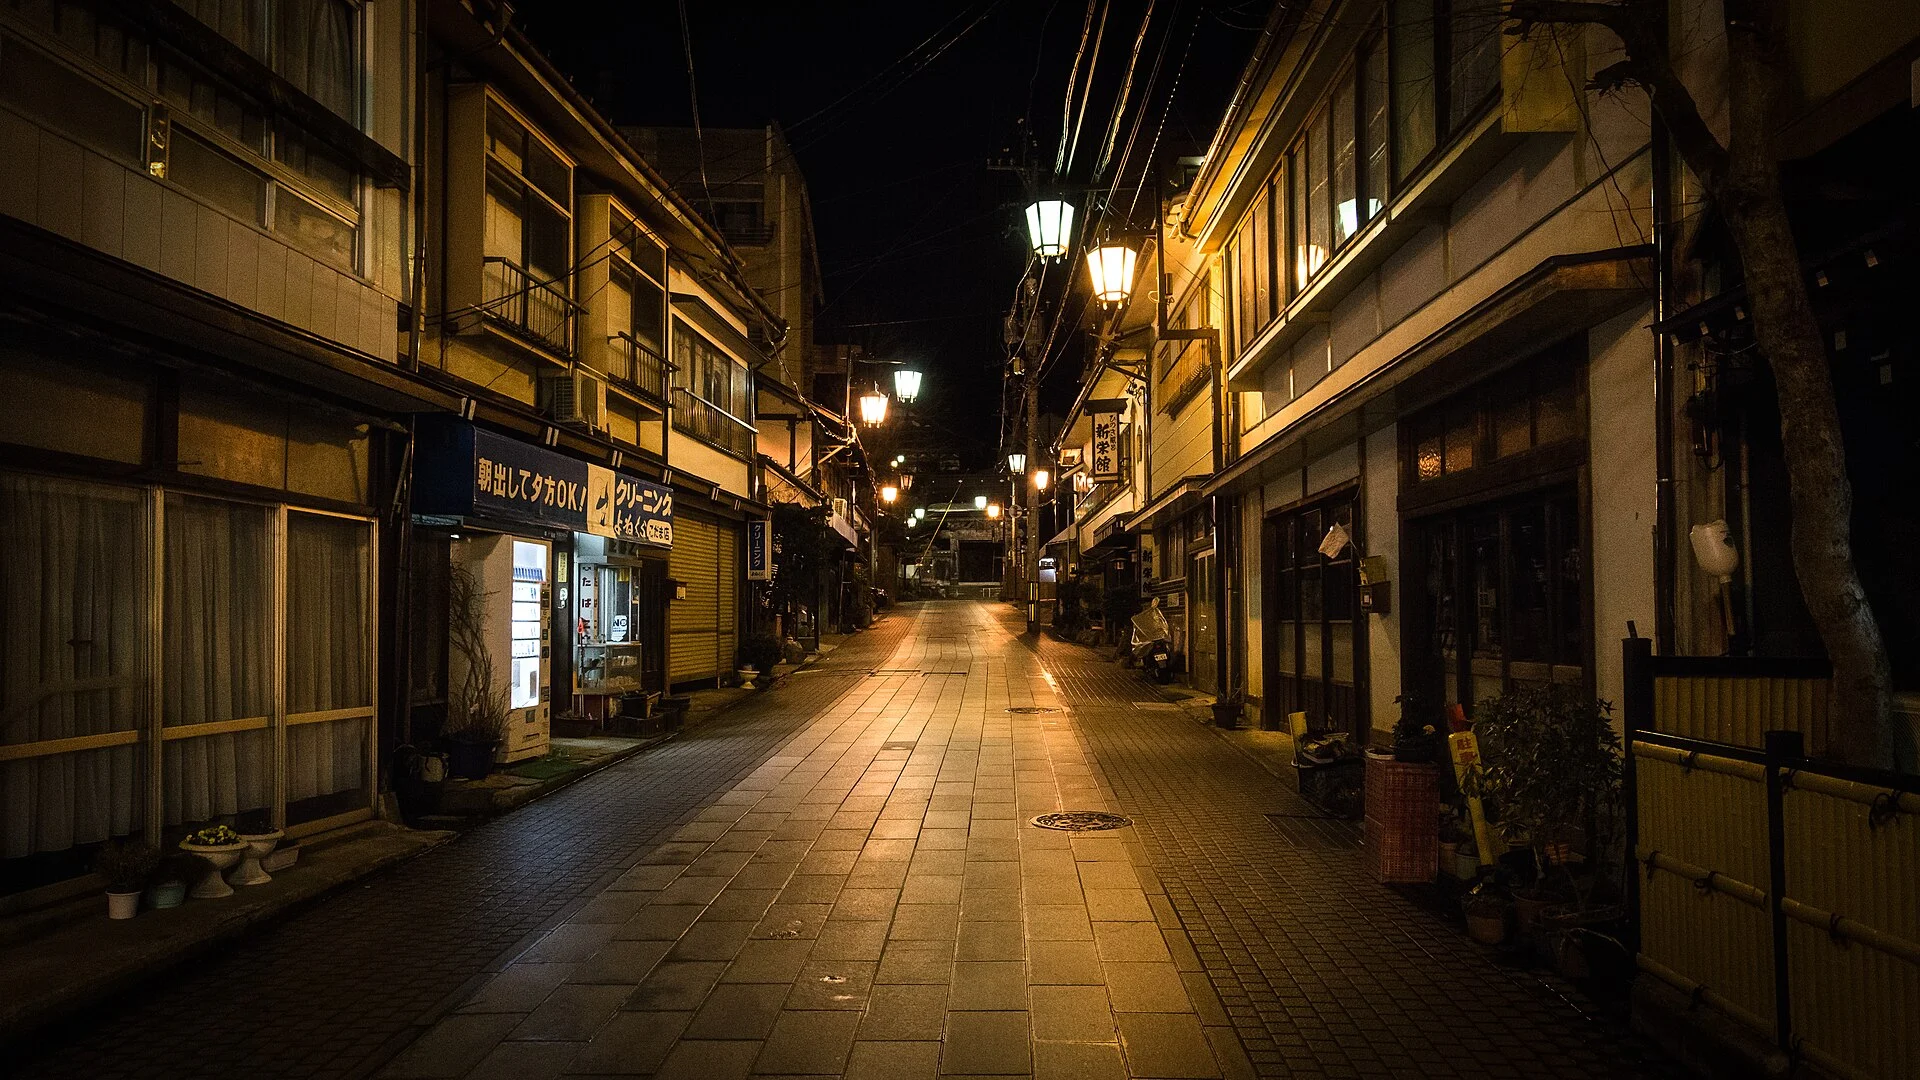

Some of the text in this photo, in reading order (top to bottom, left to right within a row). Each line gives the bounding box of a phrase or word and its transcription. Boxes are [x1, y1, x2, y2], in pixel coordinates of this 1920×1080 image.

[1096, 423, 1111, 472] 新栄館
[478, 457, 587, 512] 朝出して夕方OK!
[616, 478, 673, 517] クリーニング
[753, 525, 761, 567] クリーニング
